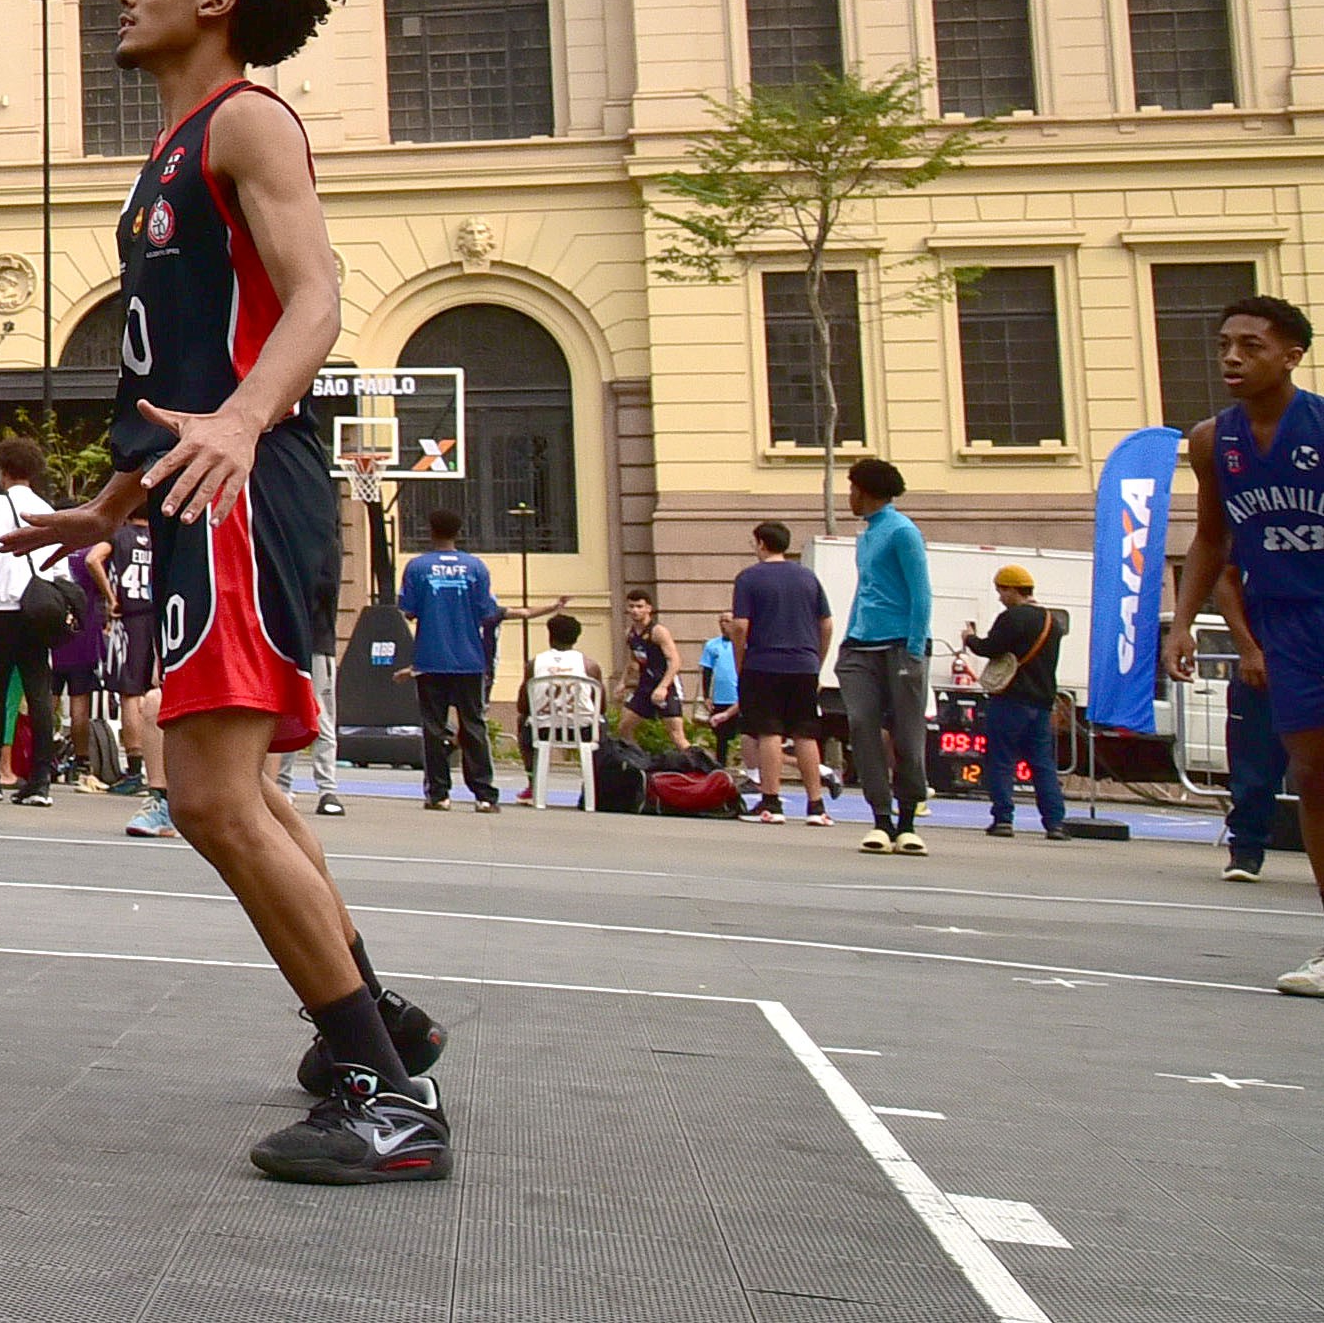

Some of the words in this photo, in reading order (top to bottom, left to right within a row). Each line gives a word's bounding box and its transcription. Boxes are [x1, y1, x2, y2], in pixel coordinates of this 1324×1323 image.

[313, 374, 349, 396] SÃO
[354, 377, 416, 395] PAULO
[431, 564, 468, 576] STAFF
[1118, 478, 1155, 675] CAIXA
